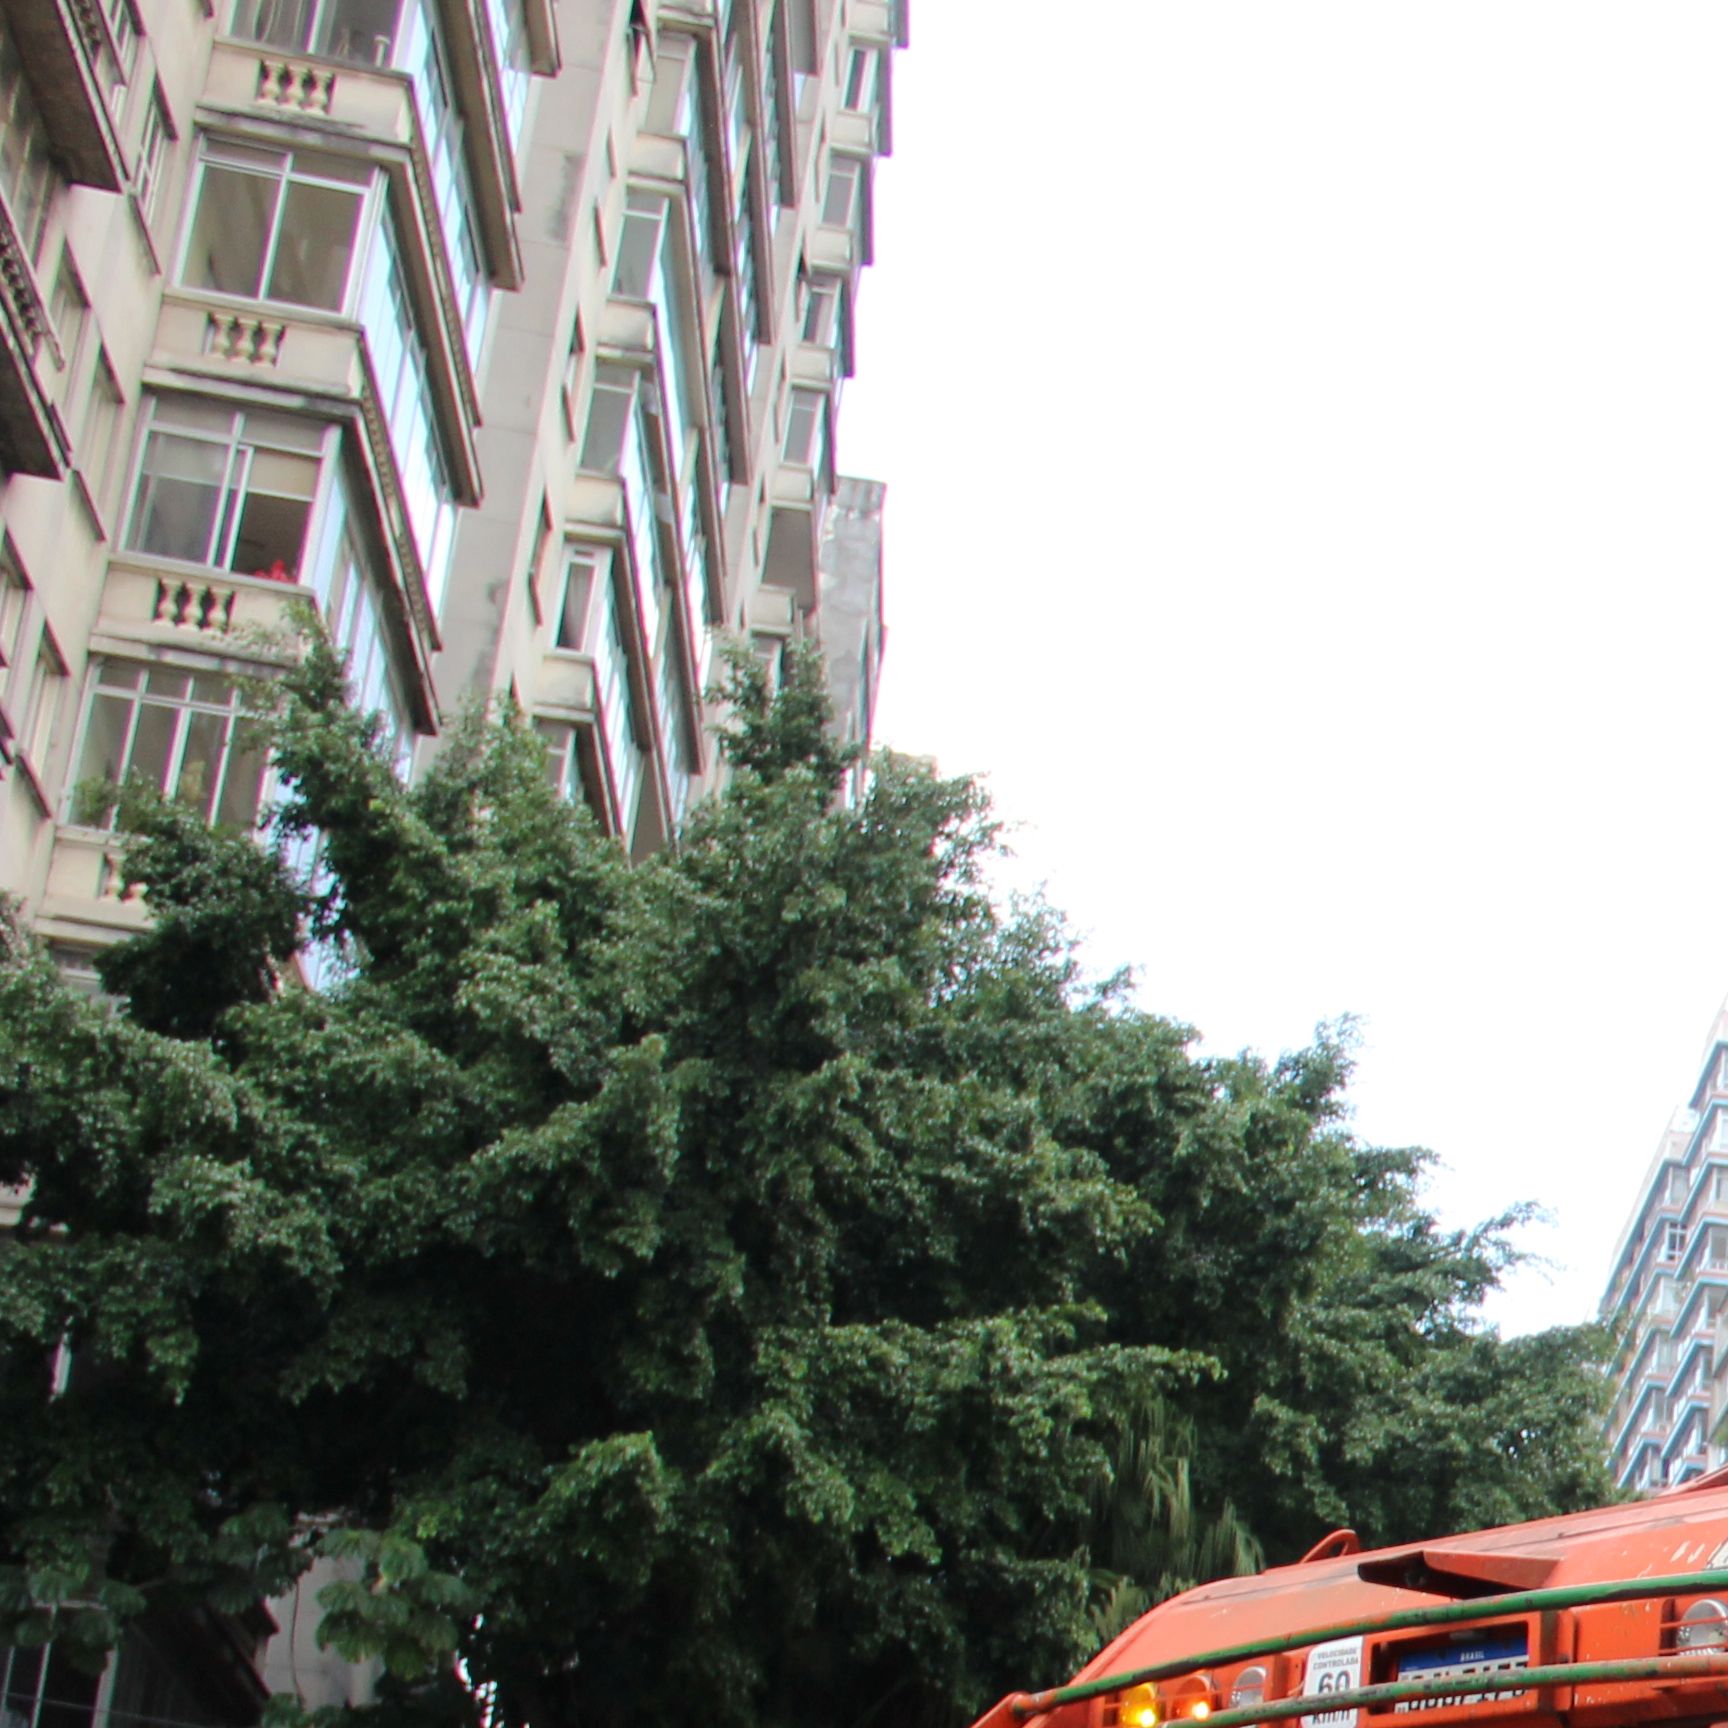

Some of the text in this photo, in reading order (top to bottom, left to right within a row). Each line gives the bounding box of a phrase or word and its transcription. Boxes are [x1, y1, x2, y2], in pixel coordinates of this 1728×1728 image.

[1316, 1647, 1357, 1660] VELOCIDADE
[1460, 1650, 1485, 1662] BRASIL
[1313, 1656, 1359, 1671] CONTROLADA
